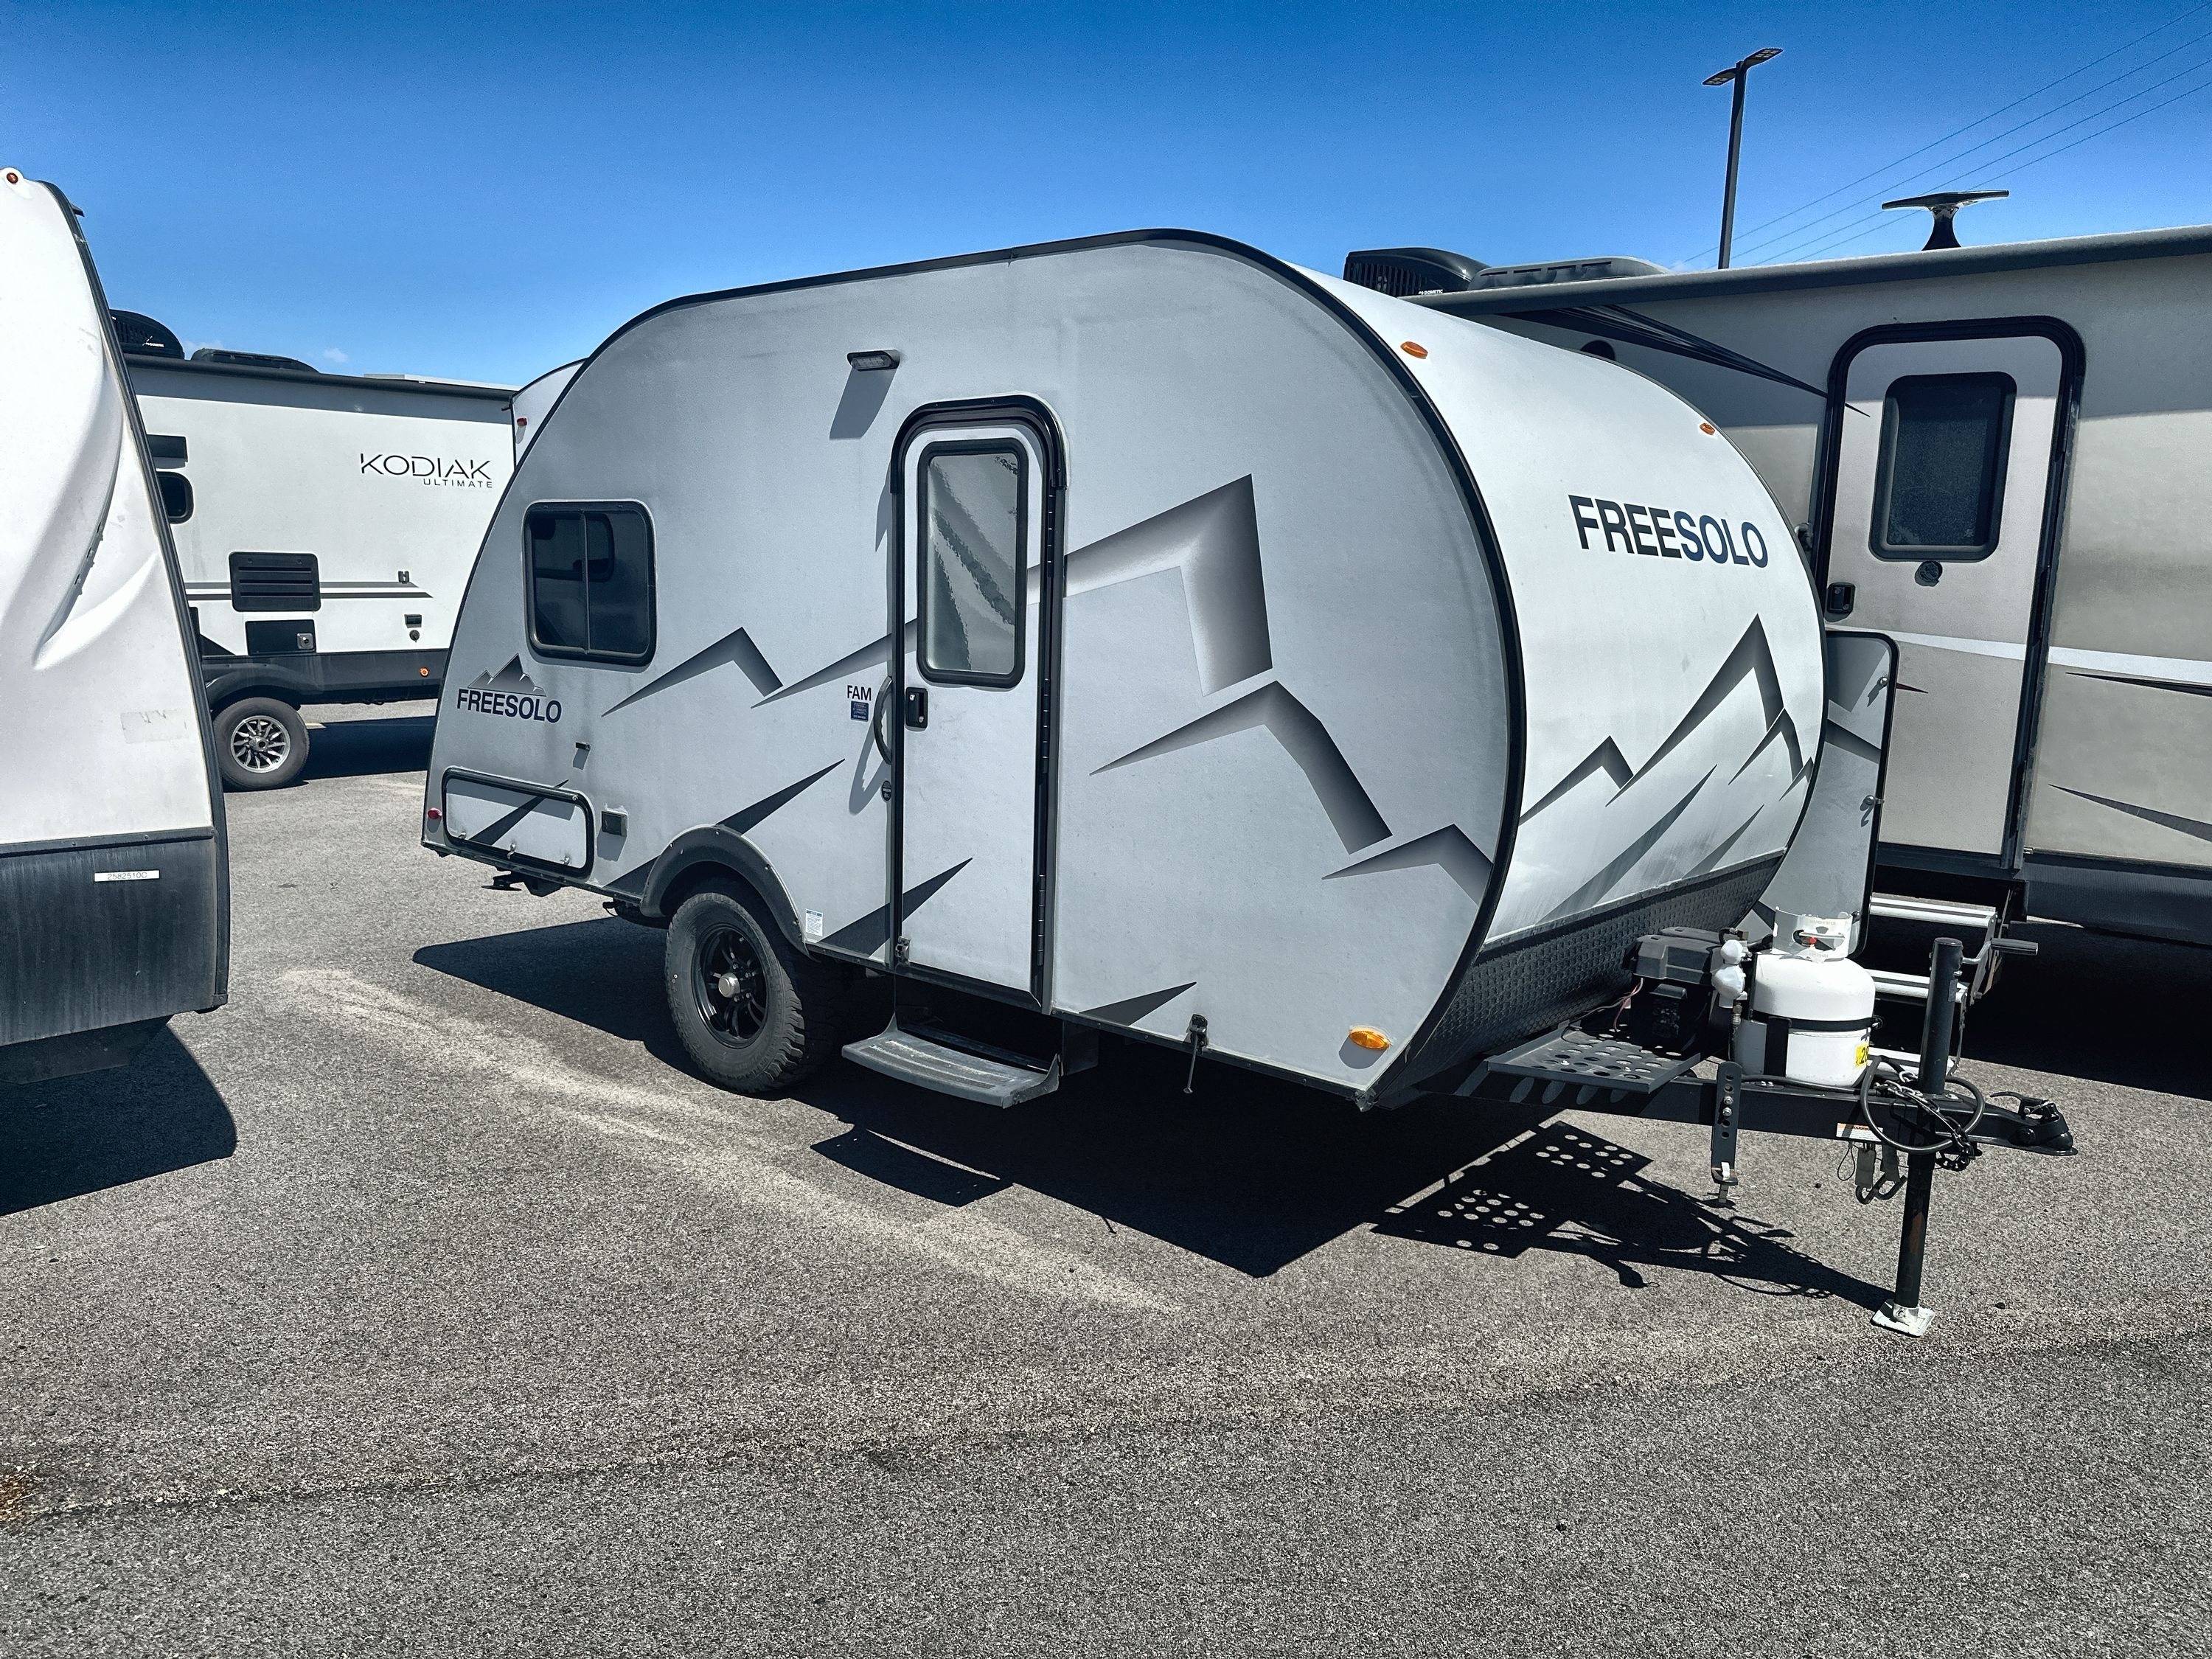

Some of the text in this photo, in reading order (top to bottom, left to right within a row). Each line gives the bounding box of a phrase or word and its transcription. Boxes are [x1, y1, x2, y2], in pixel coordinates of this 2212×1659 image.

[360, 453, 491, 480] KODIAK
[422, 478, 493, 488] ULTIMATE
[1568, 494, 1769, 568] FREESOLO
[456, 688, 562, 723] FREESOLO
[846, 684, 872, 701] FAM
